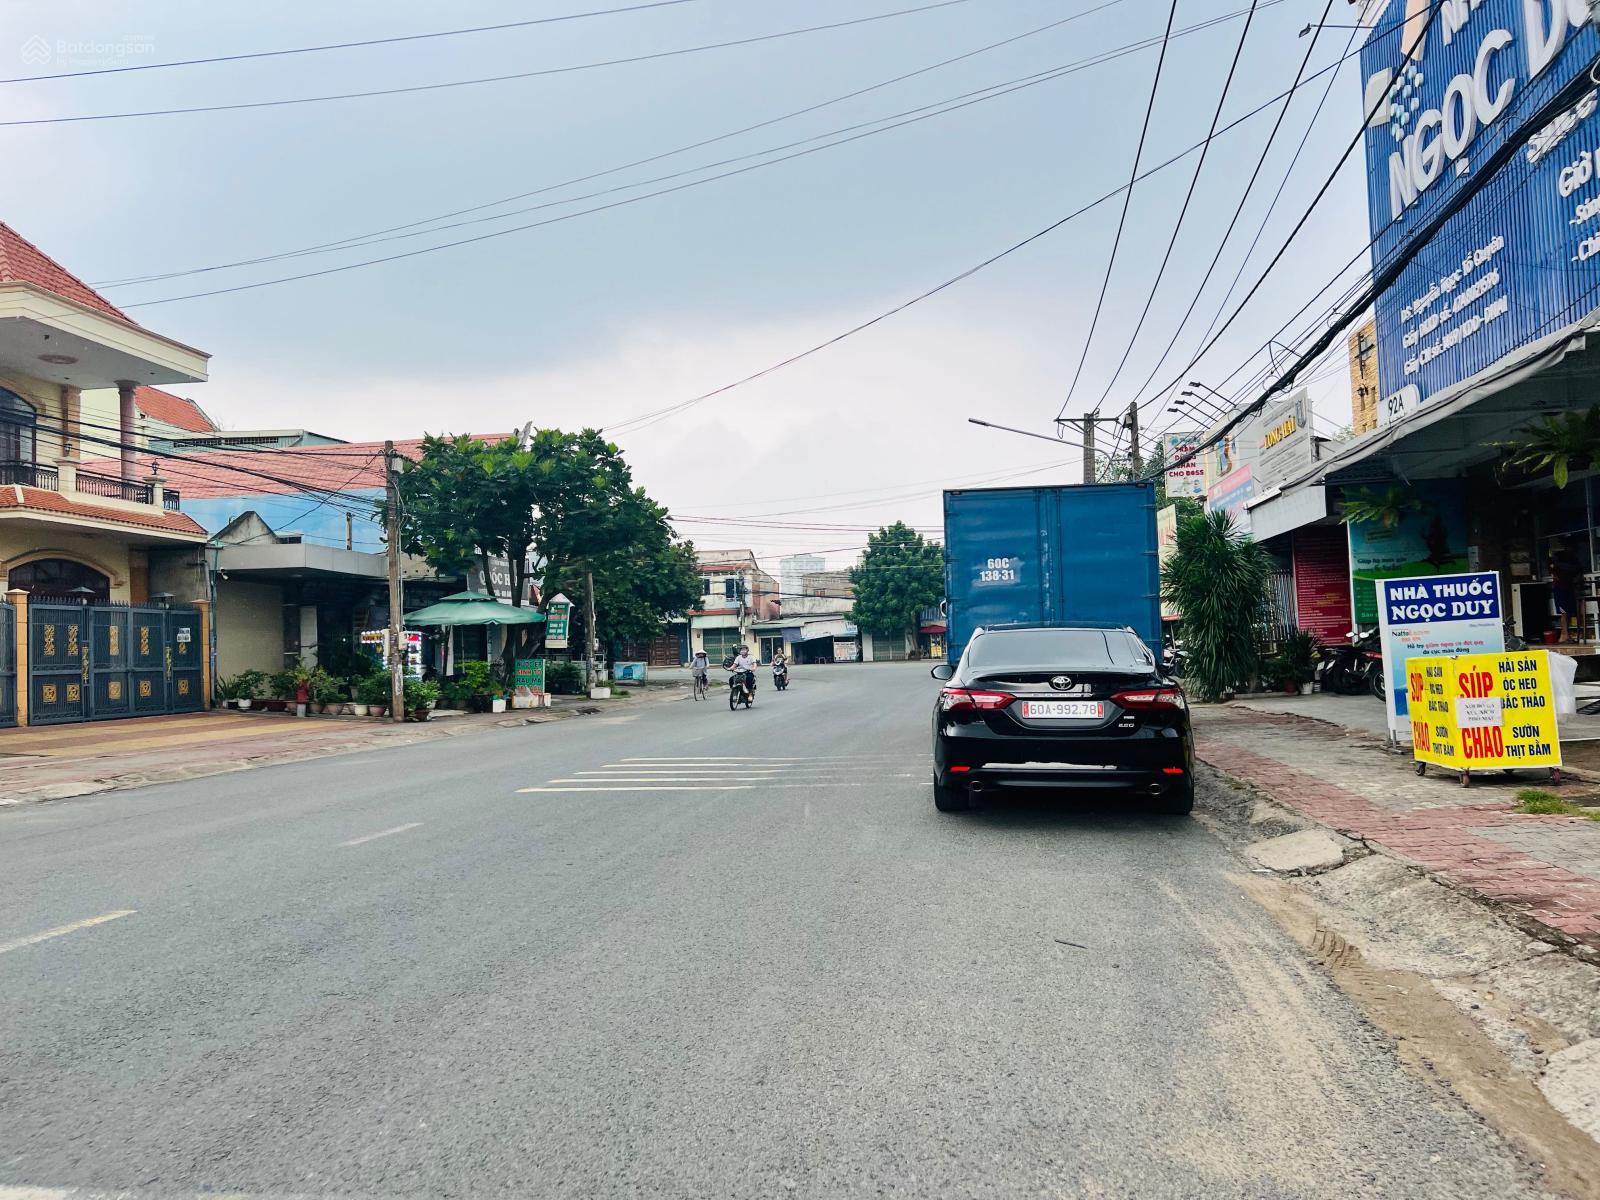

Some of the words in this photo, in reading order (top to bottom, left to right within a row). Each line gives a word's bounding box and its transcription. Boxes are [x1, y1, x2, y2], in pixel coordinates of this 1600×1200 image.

[1388, 394, 1405, 416] 92A
[987, 558, 1010, 569] 60C
[1390, 583, 1429, 601] NHÀ
[1433, 578, 1493, 599] THUỐC
[1391, 603, 1446, 622] NGỌC
[1451, 599, 1494, 617] DUY
[1499, 657, 1515, 673] HẢI
[1517, 656, 1537, 672] SẢN
[1458, 665, 1494, 698] SÚP
[1518, 678, 1537, 690] HEO
[1521, 692, 1546, 708] THẢO
[1512, 723, 1540, 738] SƯỜN
[1505, 744, 1526, 760] THỊT
